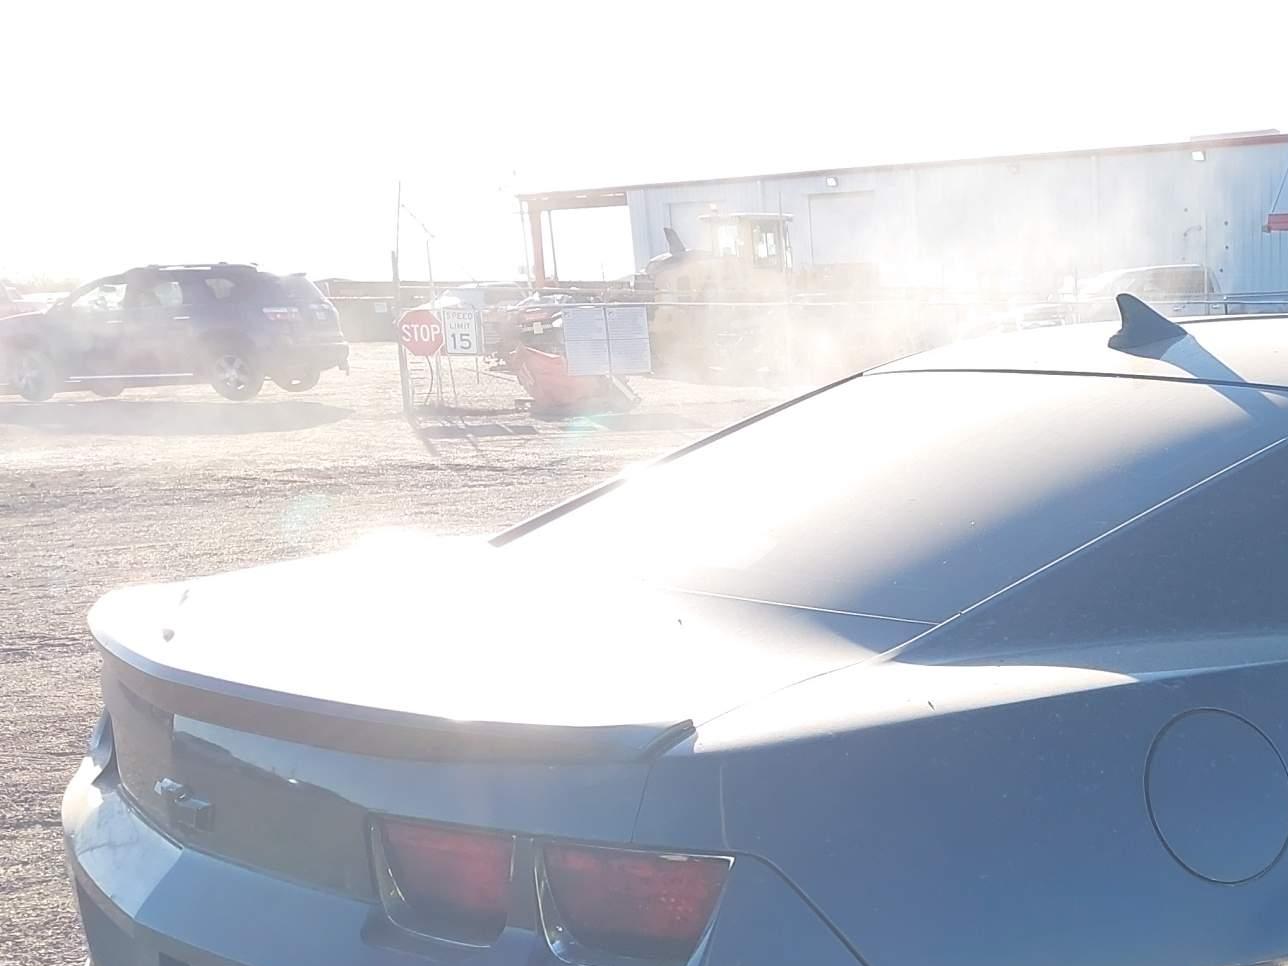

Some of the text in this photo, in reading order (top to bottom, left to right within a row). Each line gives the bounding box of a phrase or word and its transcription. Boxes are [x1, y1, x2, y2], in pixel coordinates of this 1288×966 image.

[448, 312, 474, 321] SPEED
[401, 323, 440, 343] STOP
[449, 322, 470, 330] LIMIT
[451, 332, 473, 351] 15
